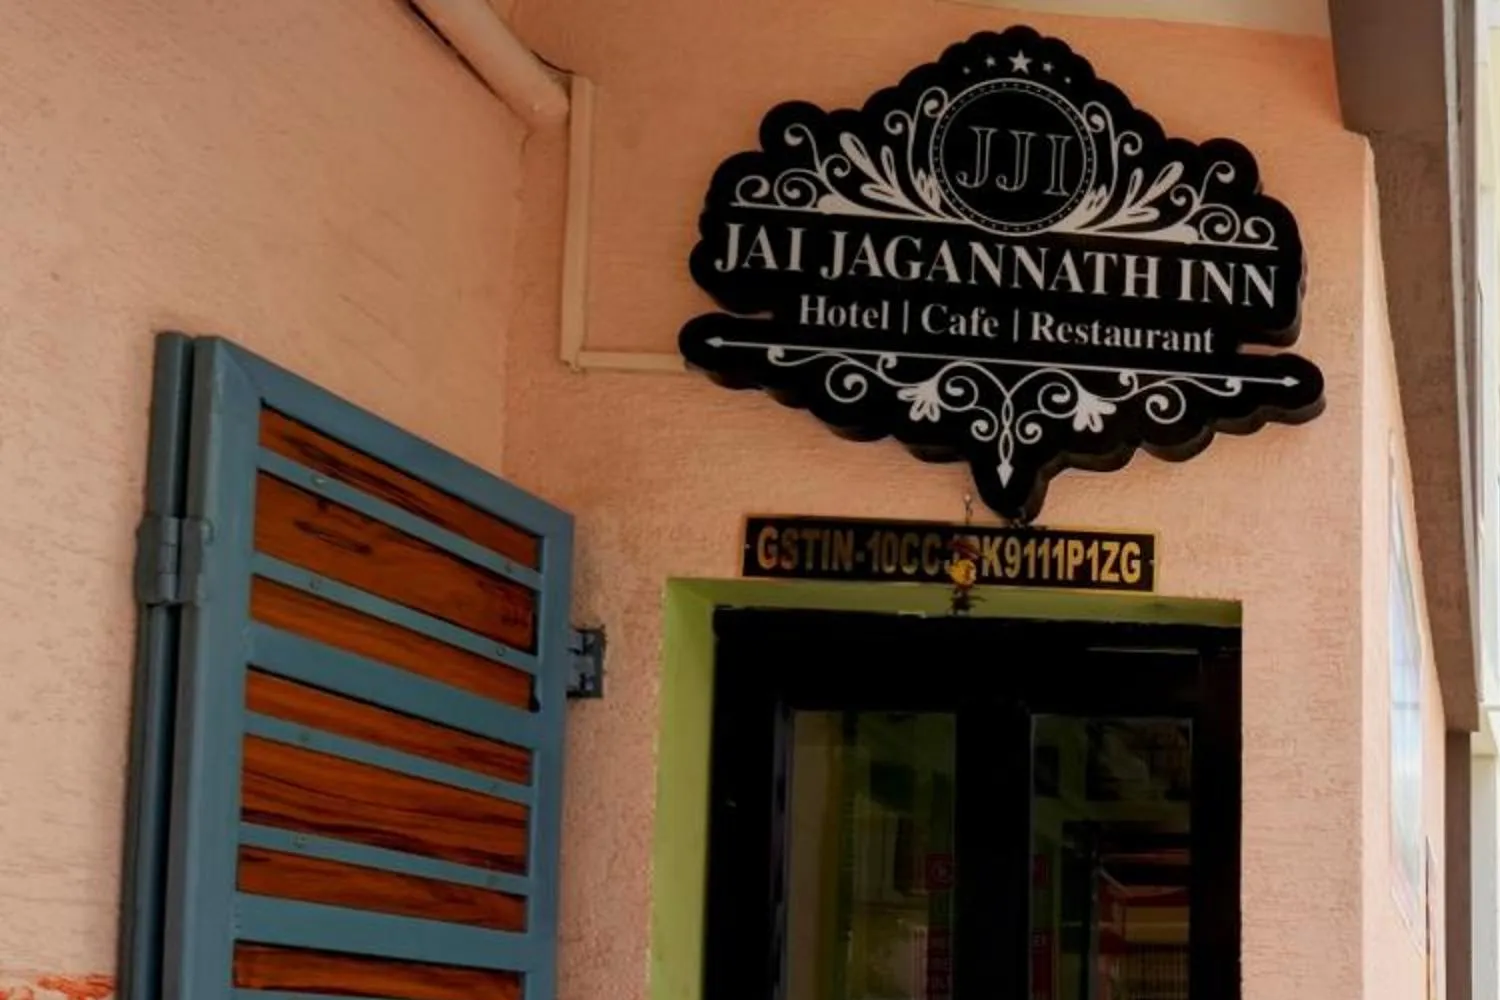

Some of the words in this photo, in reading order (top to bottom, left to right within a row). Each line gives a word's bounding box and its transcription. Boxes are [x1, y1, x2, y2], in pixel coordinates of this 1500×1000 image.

[956, 125, 1074, 197] JJI
[713, 222, 807, 273] JAI
[819, 230, 1161, 299] JAGANNATH
[1178, 257, 1279, 309] INN
[800, 294, 889, 330] Hotel
[920, 303, 1000, 338] Cafe
[1030, 310, 1215, 354] Restaurant
